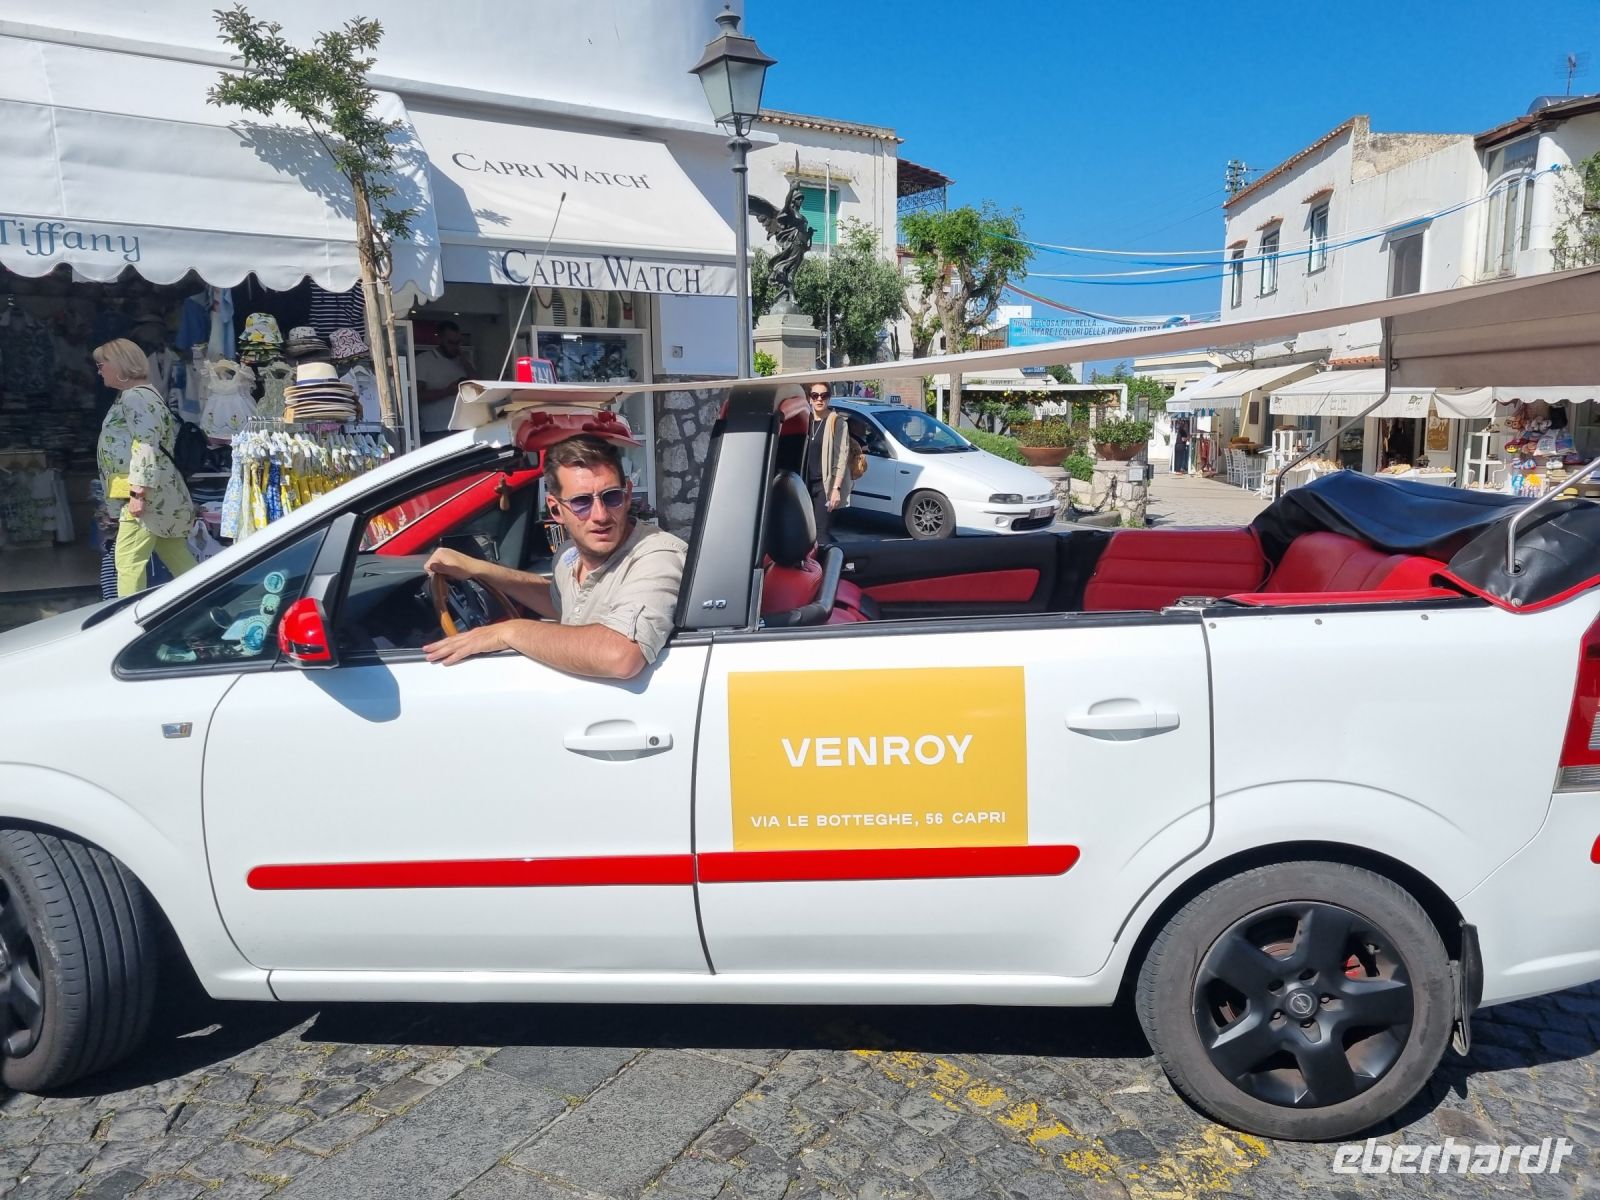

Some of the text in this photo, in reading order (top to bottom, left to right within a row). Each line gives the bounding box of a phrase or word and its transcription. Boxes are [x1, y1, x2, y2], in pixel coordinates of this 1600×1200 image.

[451, 152, 545, 179] CAPRI
[0, 219, 141, 262] Tiffany
[501, 249, 595, 288] CAPRI
[1042, 319, 1059, 327] COSA
[1058, 327, 1083, 336] COLORI
[1083, 327, 1106, 336] DELLA
[1107, 326, 1137, 335] PROPRIA
[780, 734, 974, 768] VENROY
[750, 811, 1006, 827] VIA LE BOTTEGHE, 56 CAPRI
